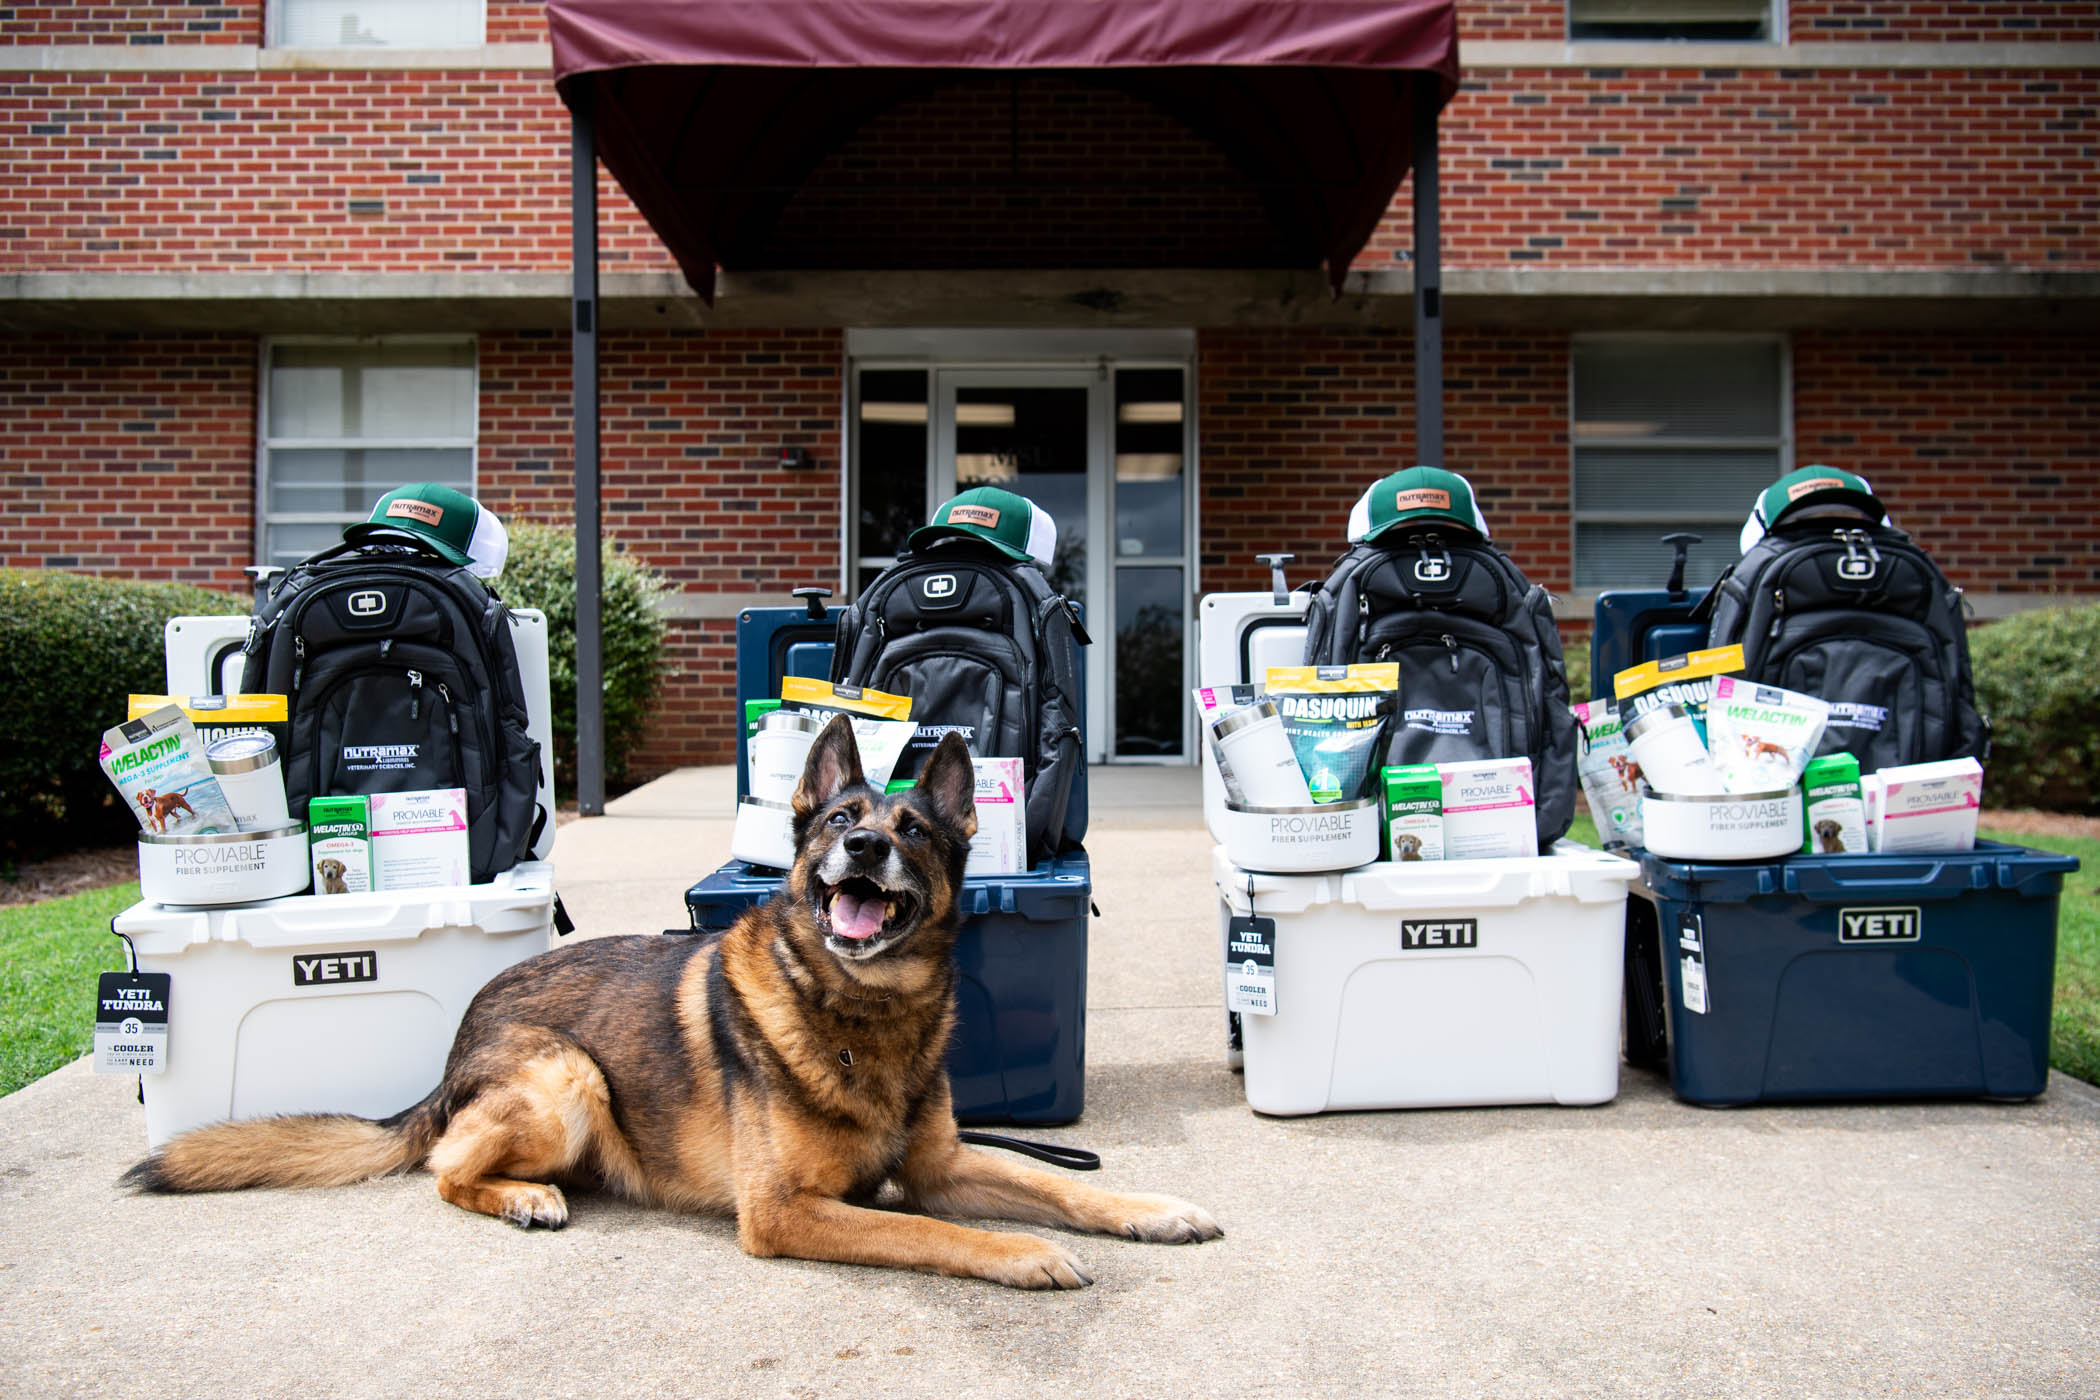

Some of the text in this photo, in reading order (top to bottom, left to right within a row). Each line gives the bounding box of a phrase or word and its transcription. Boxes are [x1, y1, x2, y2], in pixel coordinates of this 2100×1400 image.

[1634, 680, 1711, 714] DASUQUI
[1282, 696, 1377, 720] DASUQUIN
[1728, 705, 1807, 726] WELACTIN
[1589, 720, 1624, 740] WELA
[111, 734, 181, 776] WELACTIN
[119, 752, 190, 785] MEGA-3 SUPPLEMENT
[1461, 784, 1511, 798] PROVIABLE
[393, 808, 445, 821] PROVIABLE
[1710, 801, 1788, 821] PROVIABLE
[313, 824, 351, 834] WELACTIN
[1271, 815, 1351, 833] PROVIABLE
[1711, 819, 1788, 831] FIBER SUPPLEMENT
[1272, 832, 1352, 843] FIBER SUPPLEMENT
[175, 844, 265, 865] PROVIABLE
[176, 862, 265, 875] FIBER SUPPLEMENT
[1845, 914, 1913, 937] YETI
[1240, 931, 1262, 943] YETI
[1404, 923, 1472, 945] YETI
[1230, 941, 1271, 955] TUNDRA
[296, 956, 371, 981] YETI
[1246, 964, 1255, 975] 35
[117, 989, 151, 1000] YETI
[1240, 985, 1266, 994] COOLER
[102, 1000, 163, 1011] TUNDRA
[125, 1023, 138, 1034] 35
[129, 1058, 154, 1066] NEED
